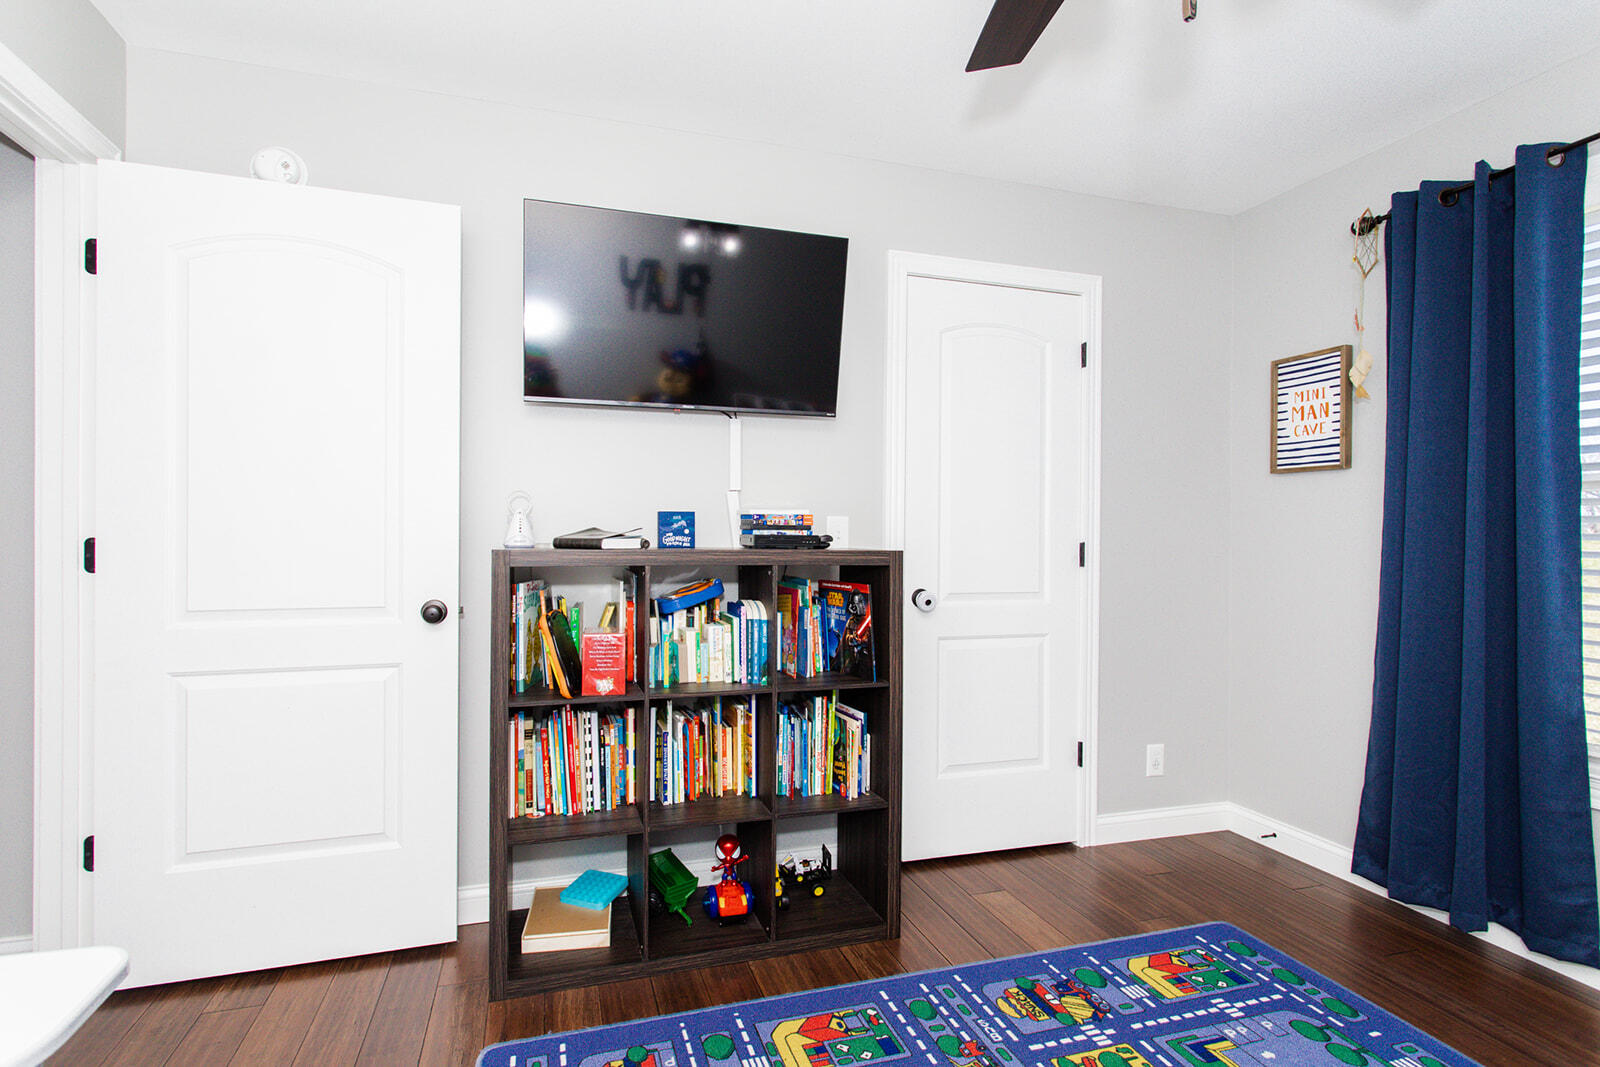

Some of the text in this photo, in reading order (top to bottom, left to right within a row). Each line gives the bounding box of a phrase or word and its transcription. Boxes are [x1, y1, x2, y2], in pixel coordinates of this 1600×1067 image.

[1294, 387, 1326, 404] MINI
[1291, 401, 1330, 423] MAN
[1294, 420, 1327, 438] CAVE
[1012, 991, 1045, 1018] SNACK
